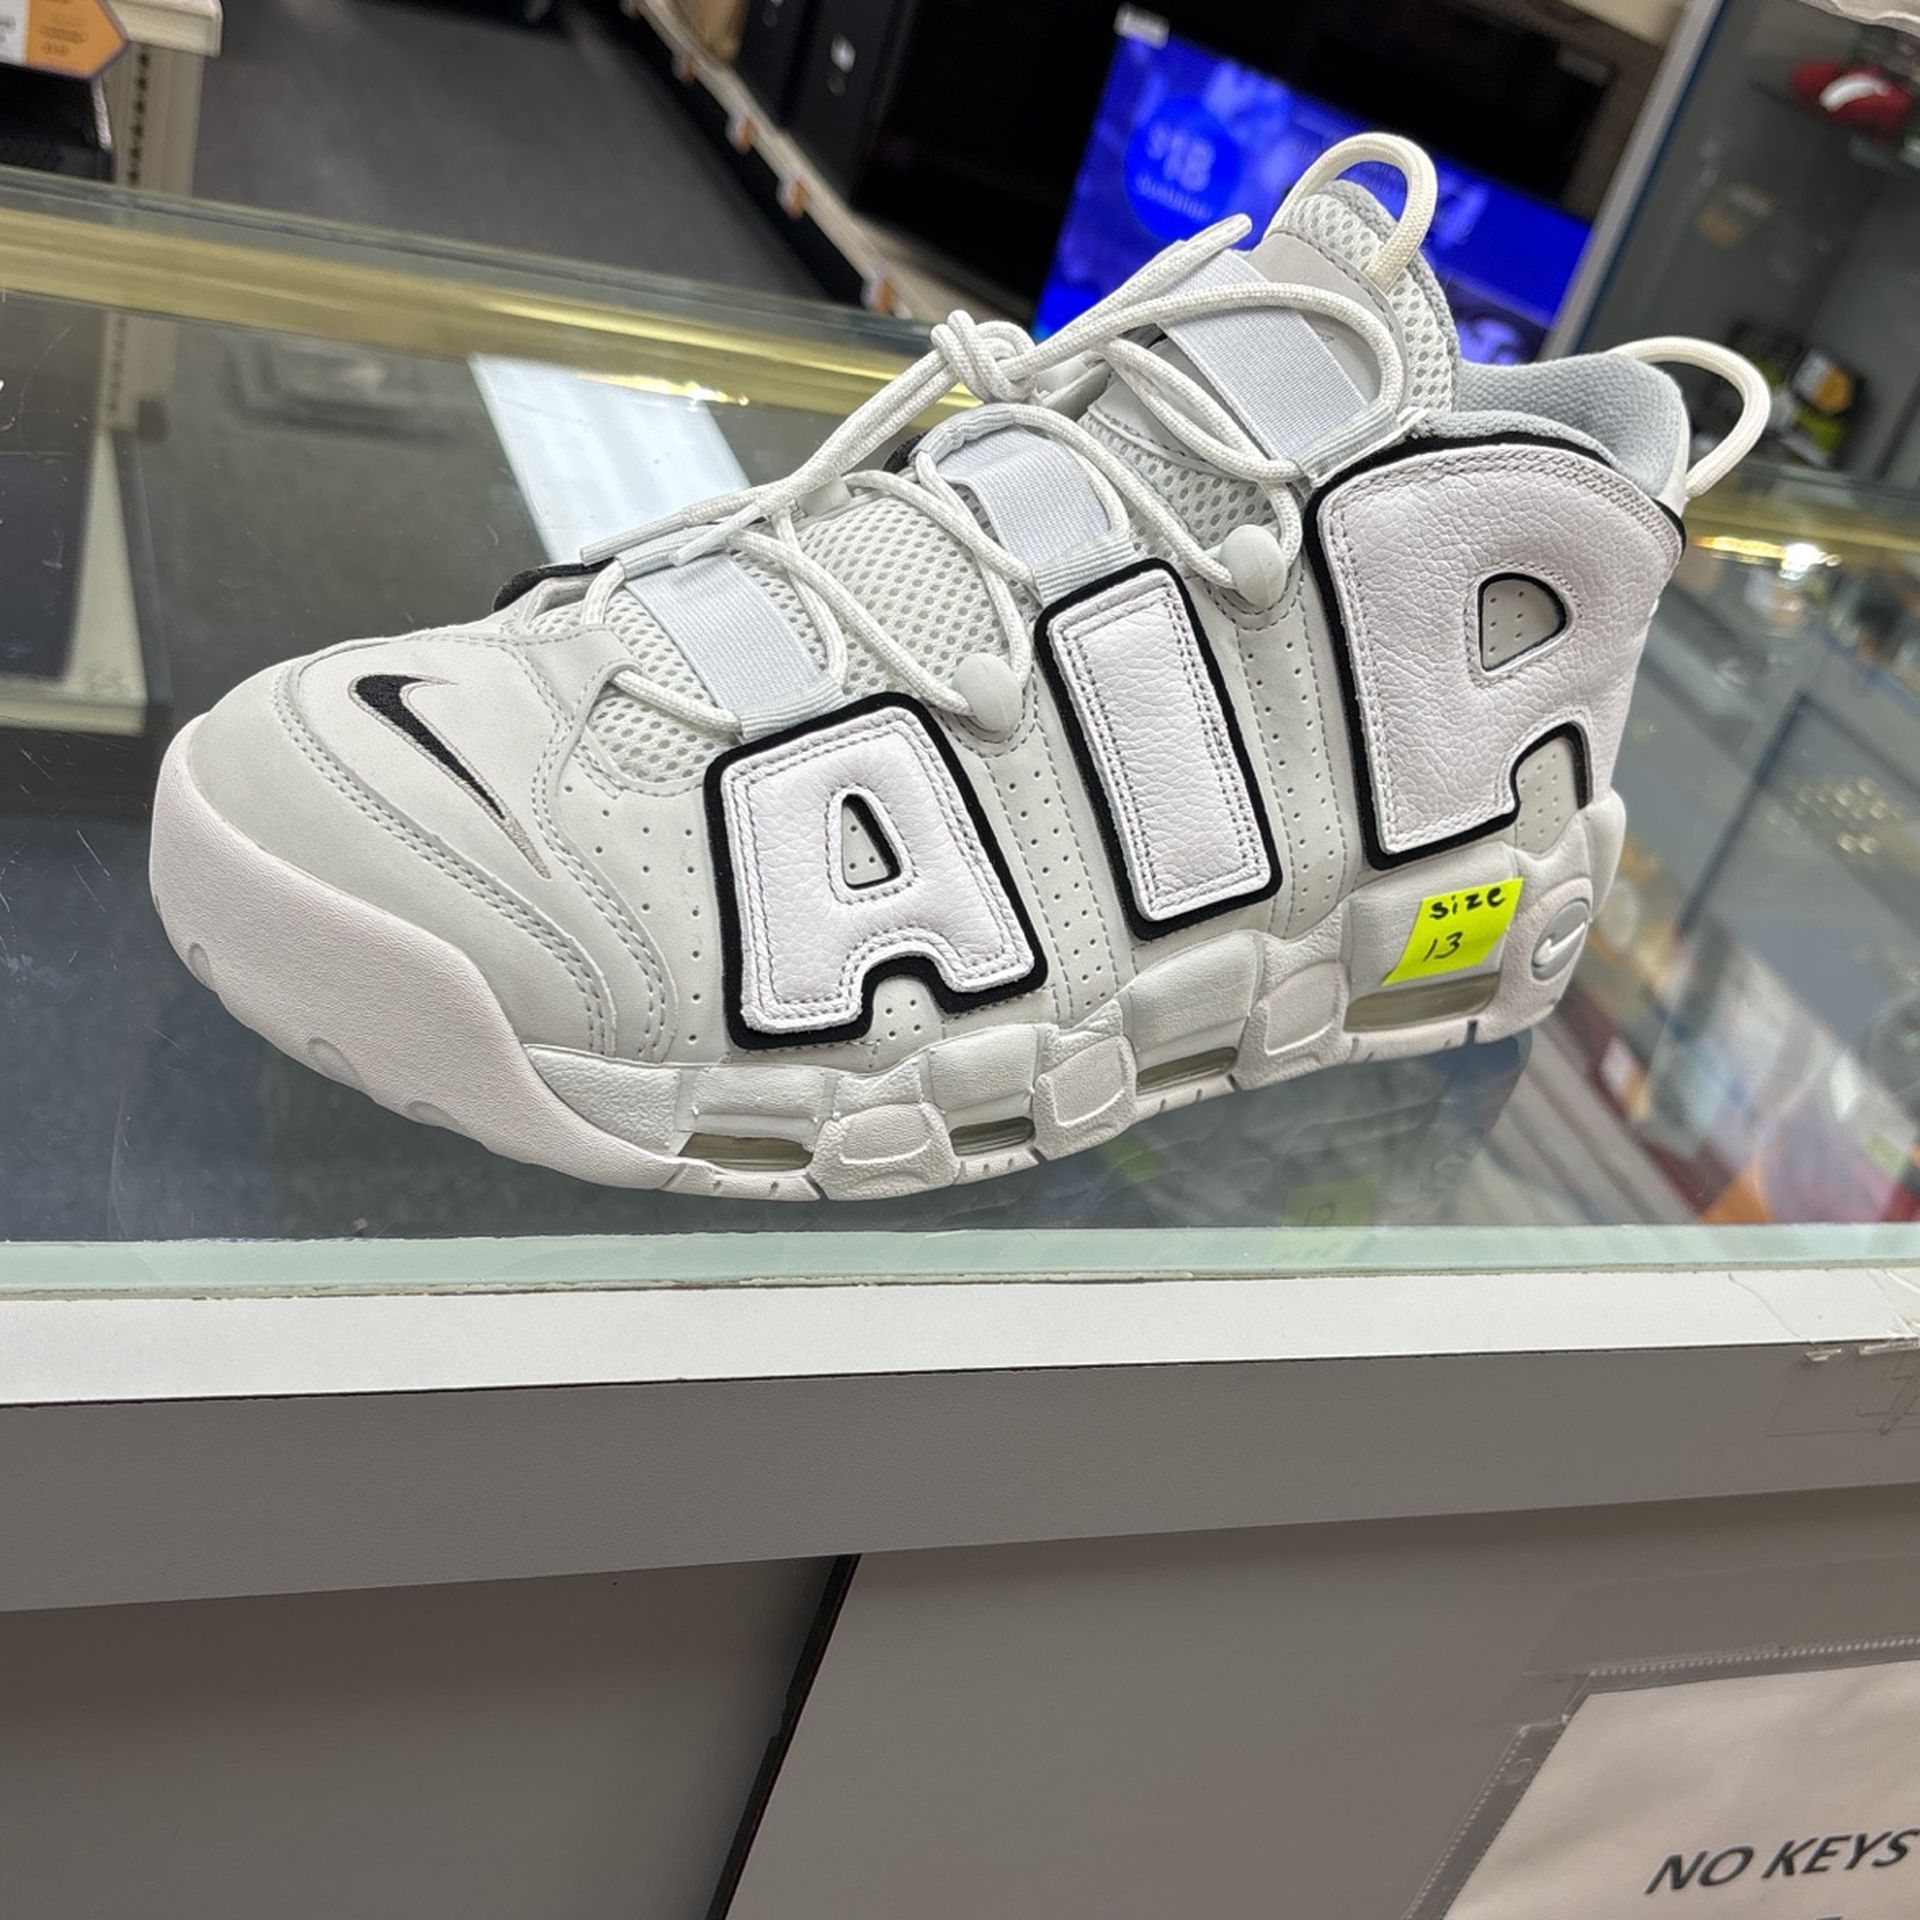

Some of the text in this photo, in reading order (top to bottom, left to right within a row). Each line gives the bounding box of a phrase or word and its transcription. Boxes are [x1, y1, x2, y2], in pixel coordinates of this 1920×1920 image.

[1428, 887, 1506, 920] size
[1422, 931, 1464, 962] 13
[1644, 1827, 1920, 1895] NO KEYS
